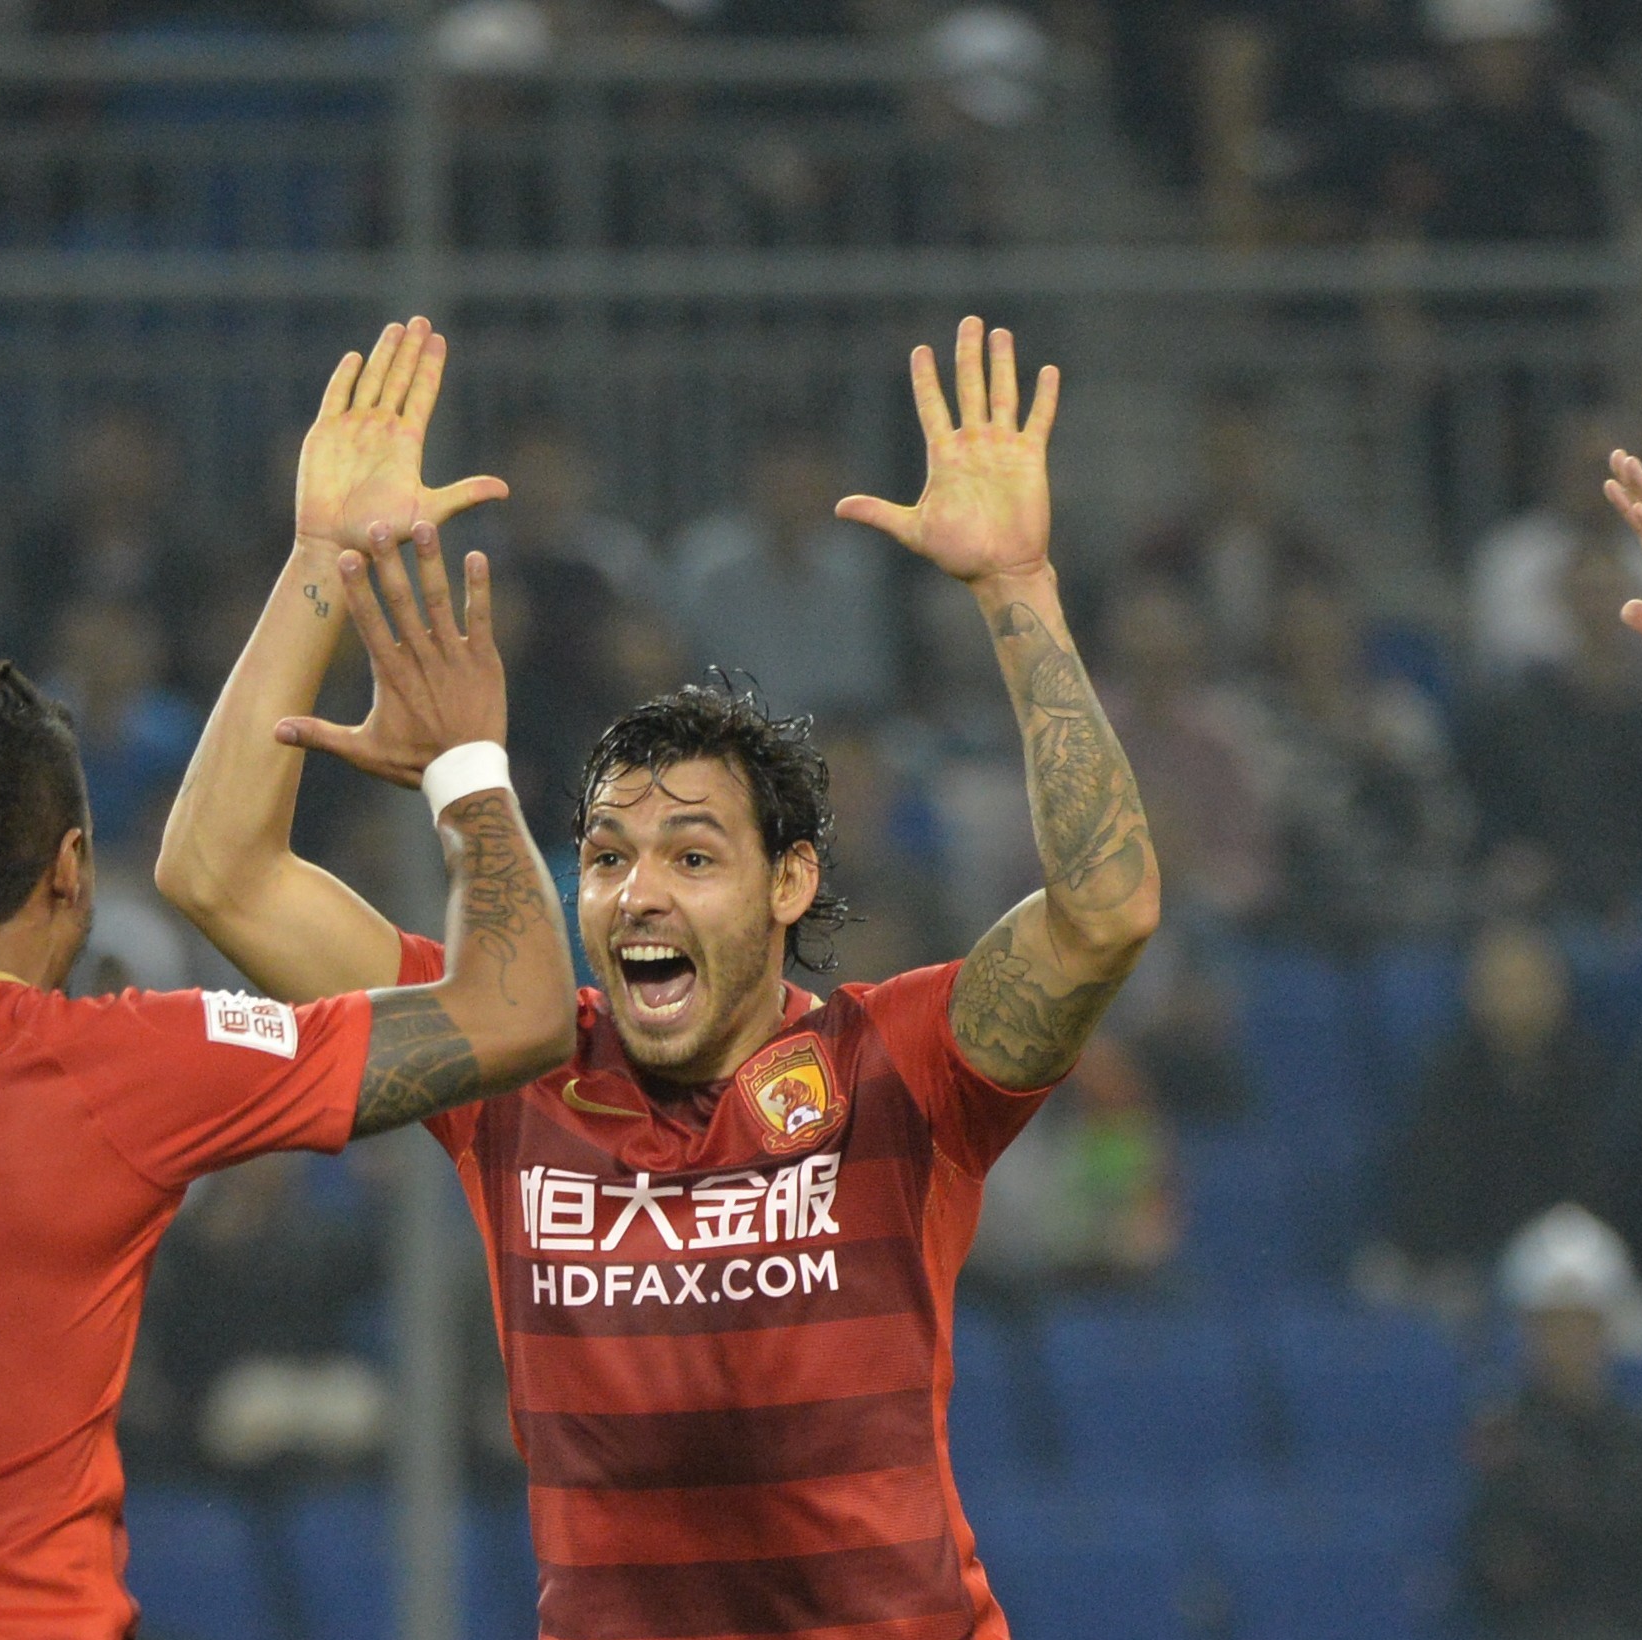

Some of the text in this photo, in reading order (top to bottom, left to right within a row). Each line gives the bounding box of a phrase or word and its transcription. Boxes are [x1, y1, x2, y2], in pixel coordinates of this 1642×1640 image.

[520, 1152, 842, 1251] 恒大金服
[532, 1250, 840, 1307] HDFAX.COM
